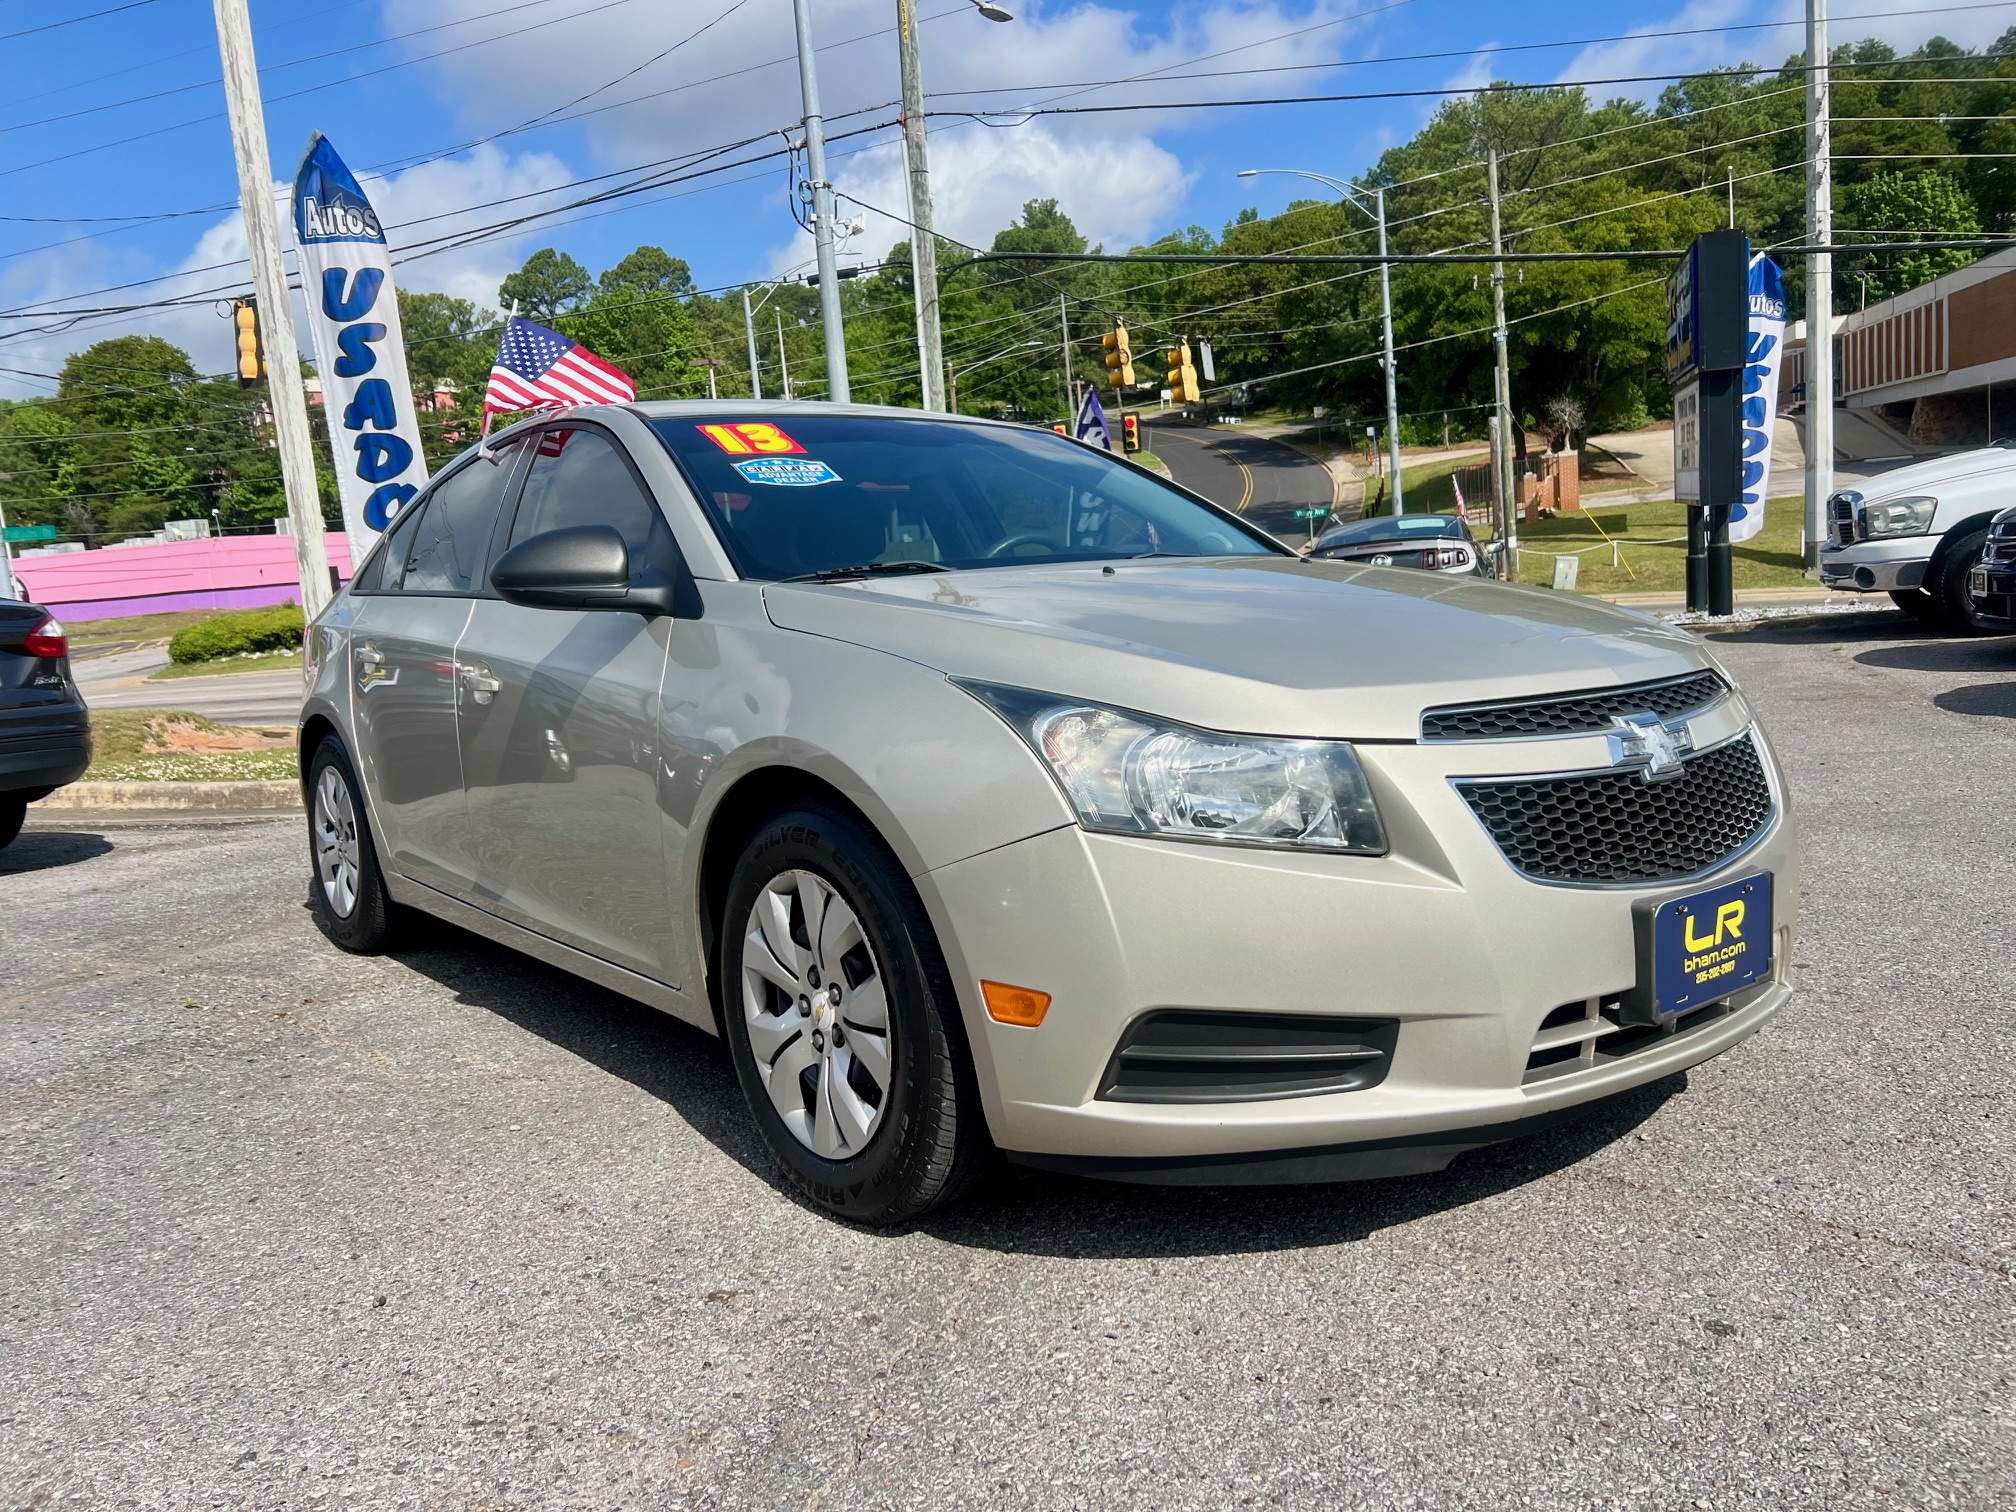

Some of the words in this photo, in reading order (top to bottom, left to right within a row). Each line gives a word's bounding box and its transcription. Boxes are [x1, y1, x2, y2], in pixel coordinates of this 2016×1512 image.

[304, 193, 380, 238] Autos
[1749, 291, 1785, 318] utos
[705, 423, 793, 452] 13
[1685, 899, 1745, 954] LR
[1684, 941, 1746, 974] bham.com
